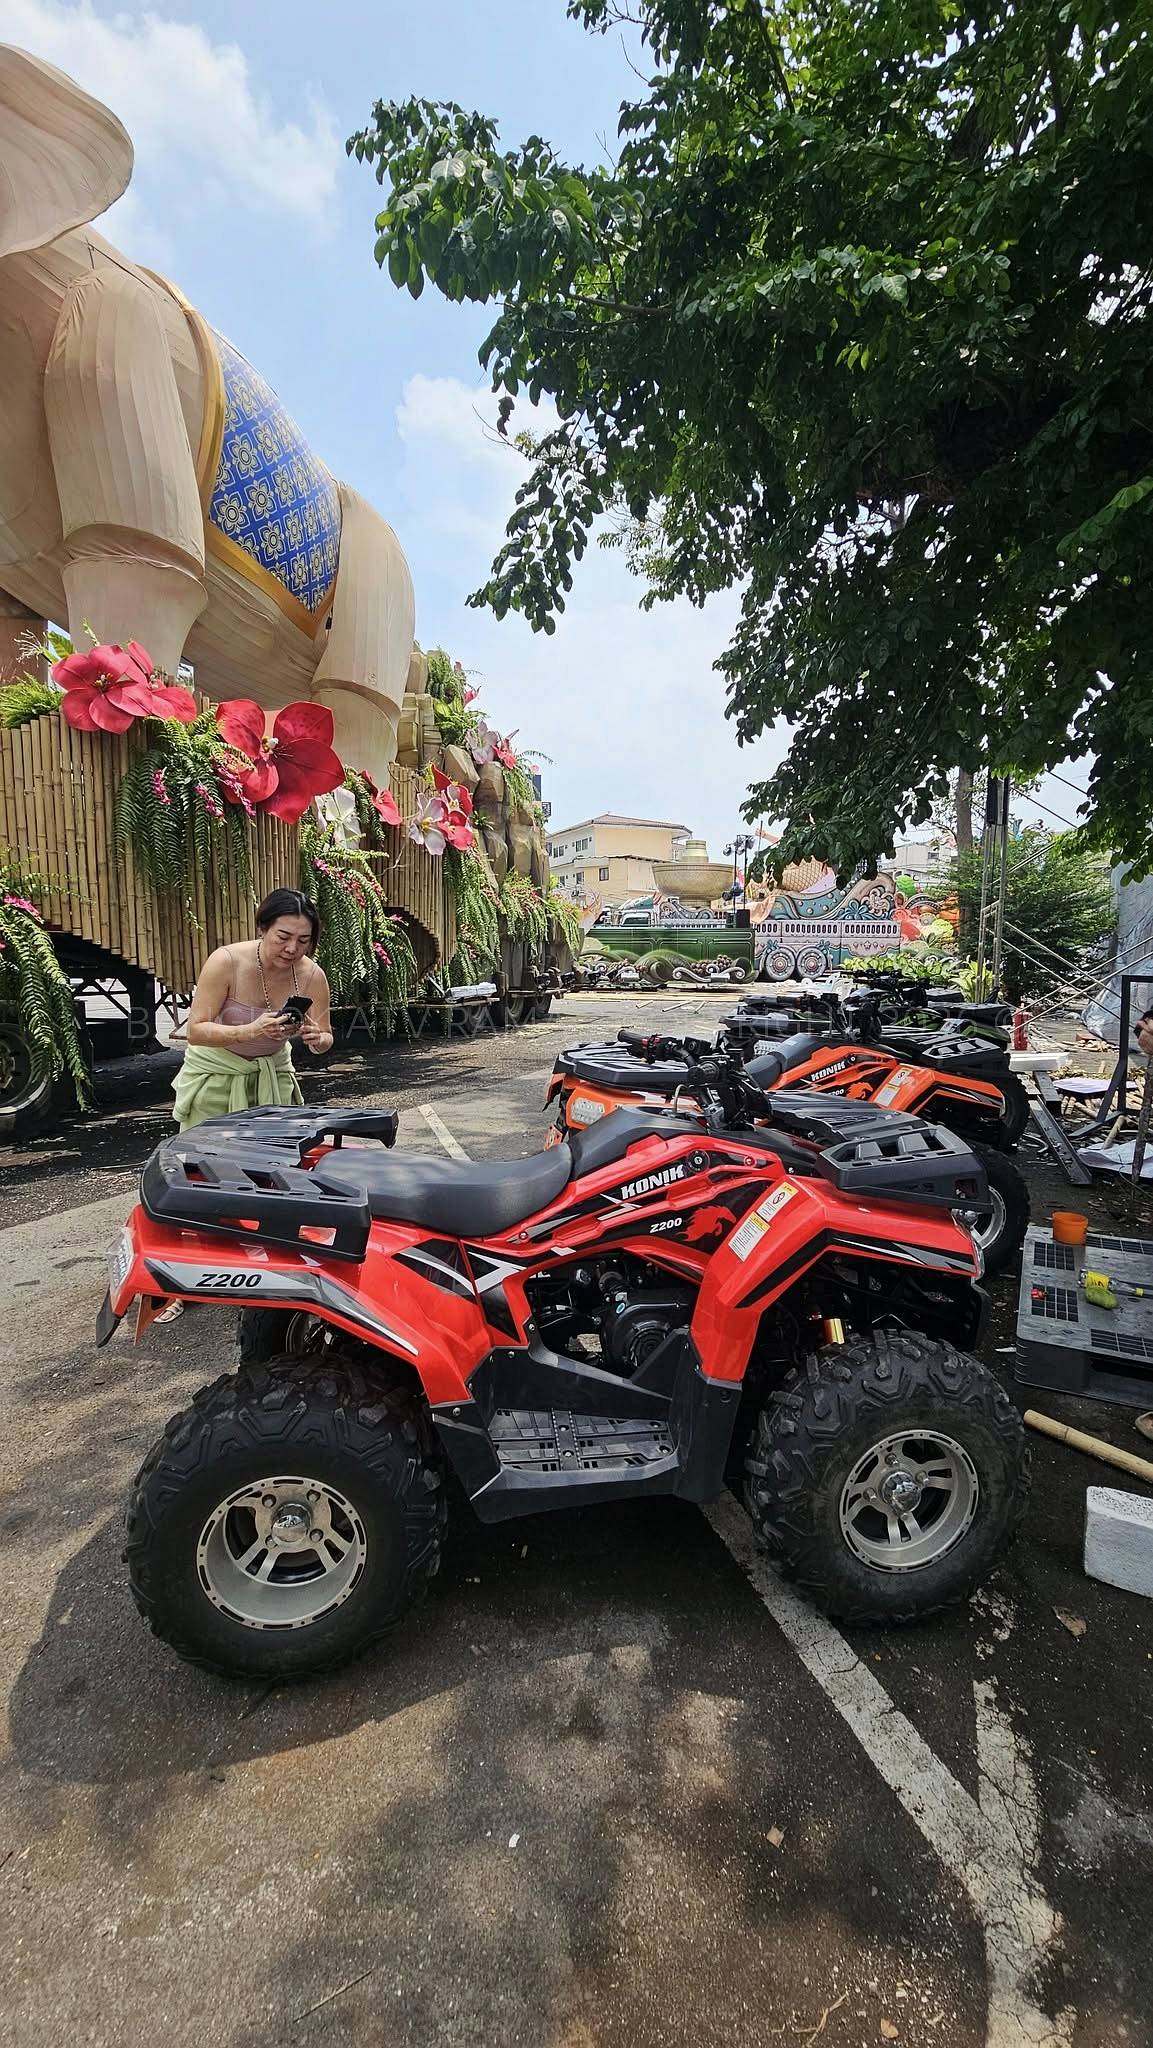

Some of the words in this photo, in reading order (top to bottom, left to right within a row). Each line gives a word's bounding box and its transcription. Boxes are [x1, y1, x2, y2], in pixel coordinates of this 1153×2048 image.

[810, 1061, 846, 1082] KONIK
[620, 1164, 684, 1200] KONIK
[649, 1217, 683, 1234] Z200
[195, 1273, 262, 1288] Z200
